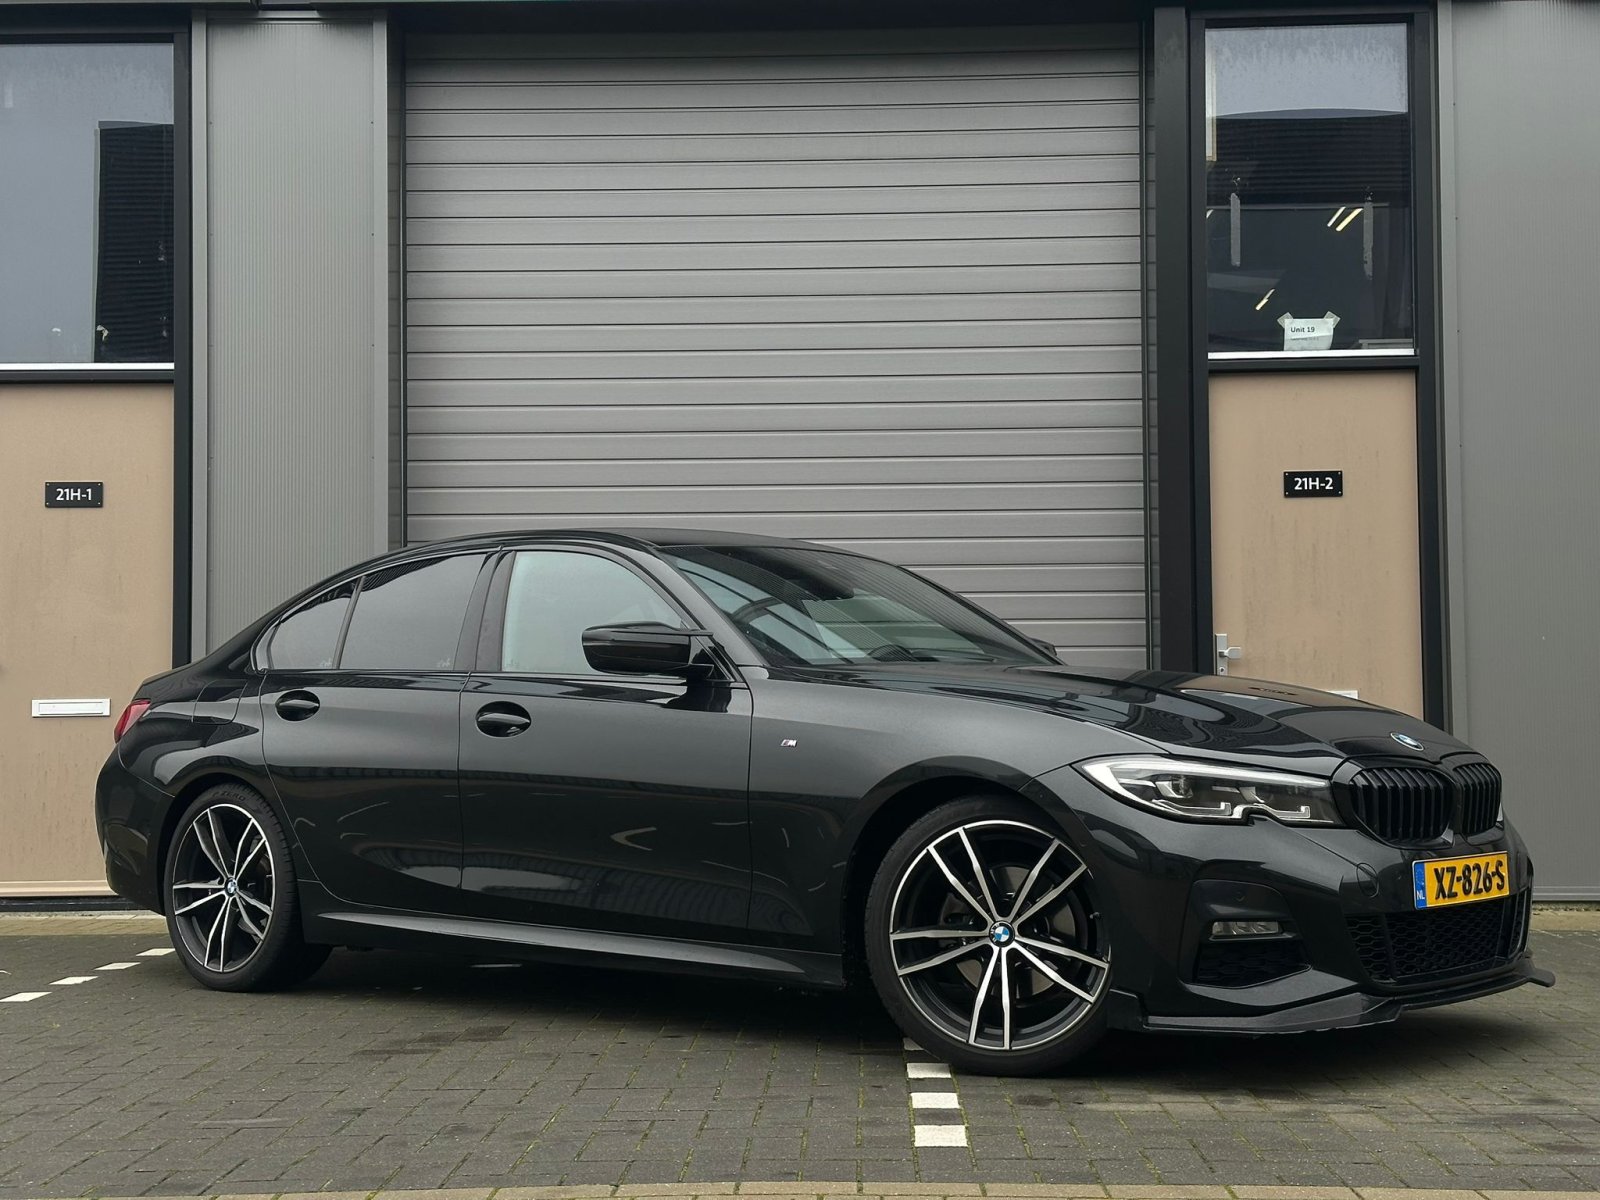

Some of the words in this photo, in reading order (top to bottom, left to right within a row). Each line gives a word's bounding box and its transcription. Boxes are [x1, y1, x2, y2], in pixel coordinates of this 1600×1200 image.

[1294, 477, 1334, 490] 21H-2
[56, 488, 92, 501] 21H-1
[1433, 860, 1505, 900] XZ-826-S
[1416, 890, 1425, 900] NL
